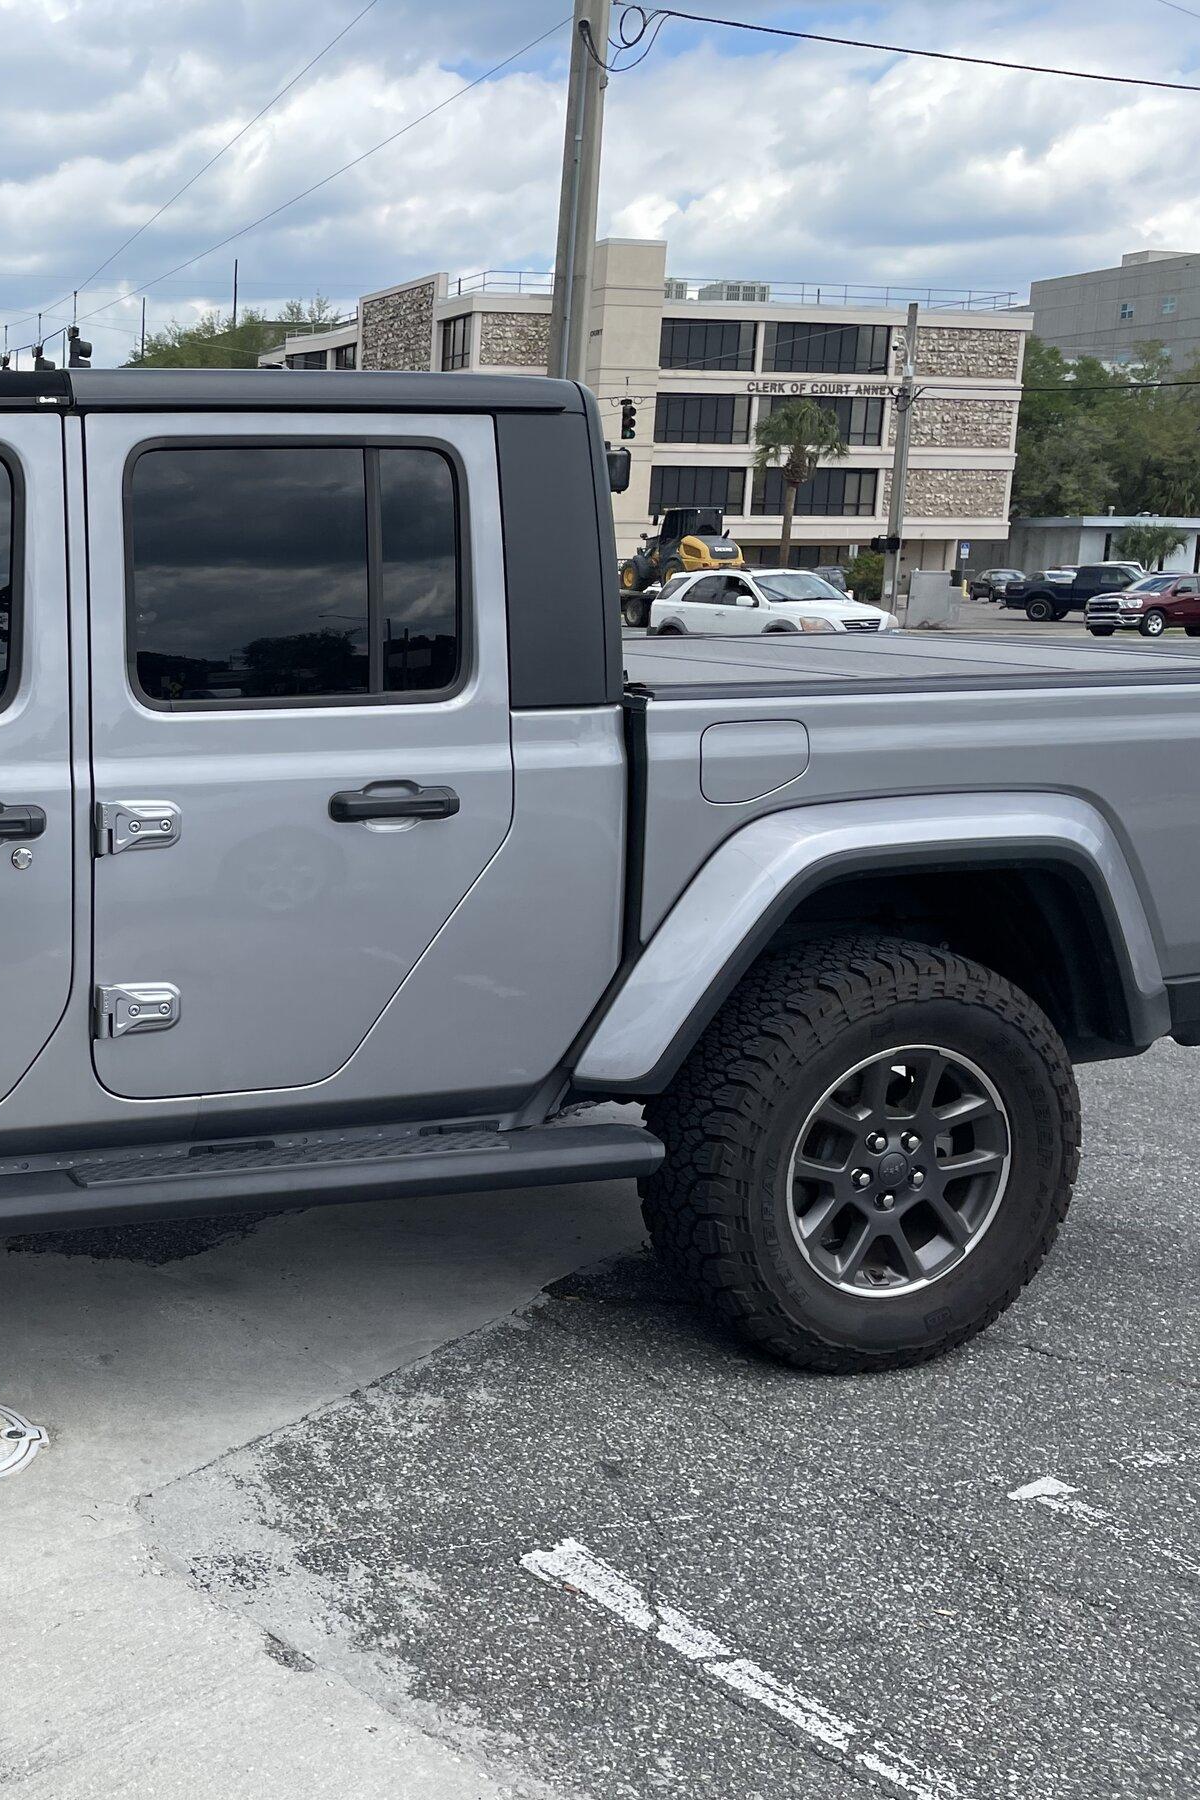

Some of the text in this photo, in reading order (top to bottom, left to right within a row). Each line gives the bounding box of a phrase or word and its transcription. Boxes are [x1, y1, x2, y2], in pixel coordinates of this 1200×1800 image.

[746, 381, 894, 396] CLERK OF COURT ANNEX
